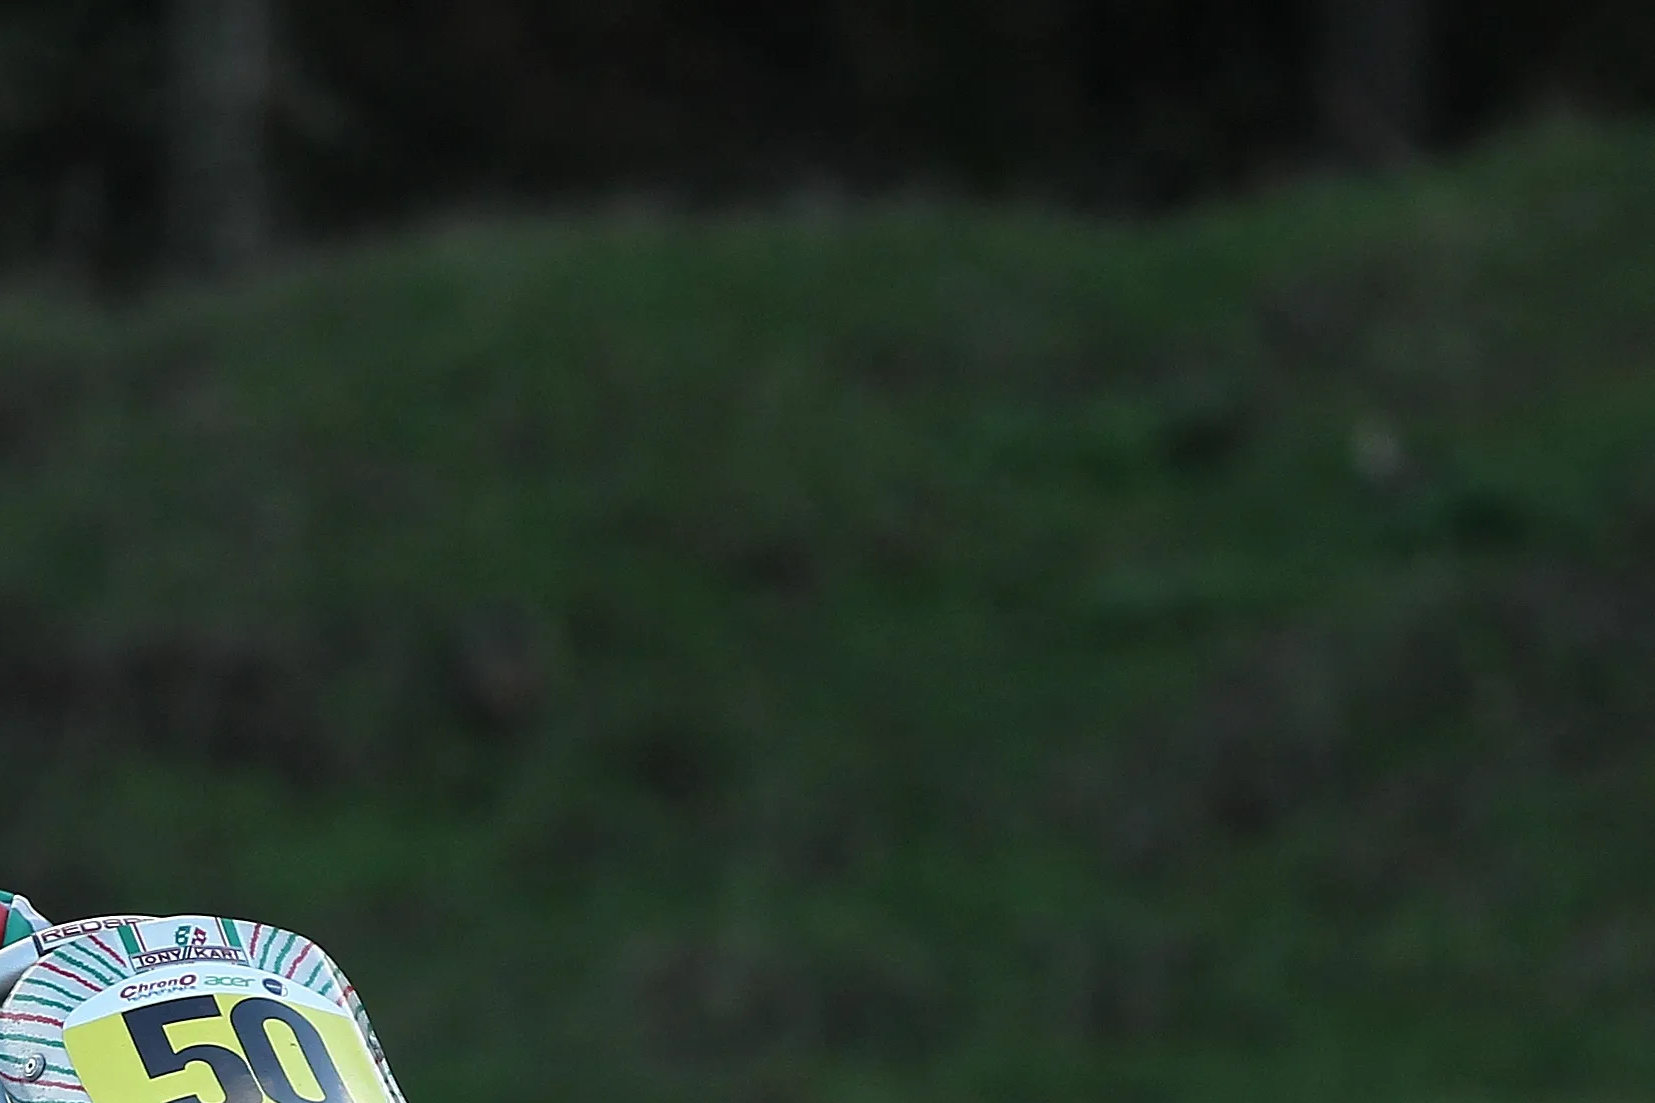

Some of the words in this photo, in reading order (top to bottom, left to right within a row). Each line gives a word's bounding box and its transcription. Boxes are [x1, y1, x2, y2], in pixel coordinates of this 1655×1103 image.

[131, 949, 182, 969] TONY
[195, 946, 243, 960] KART
[204, 976, 257, 987] acer
